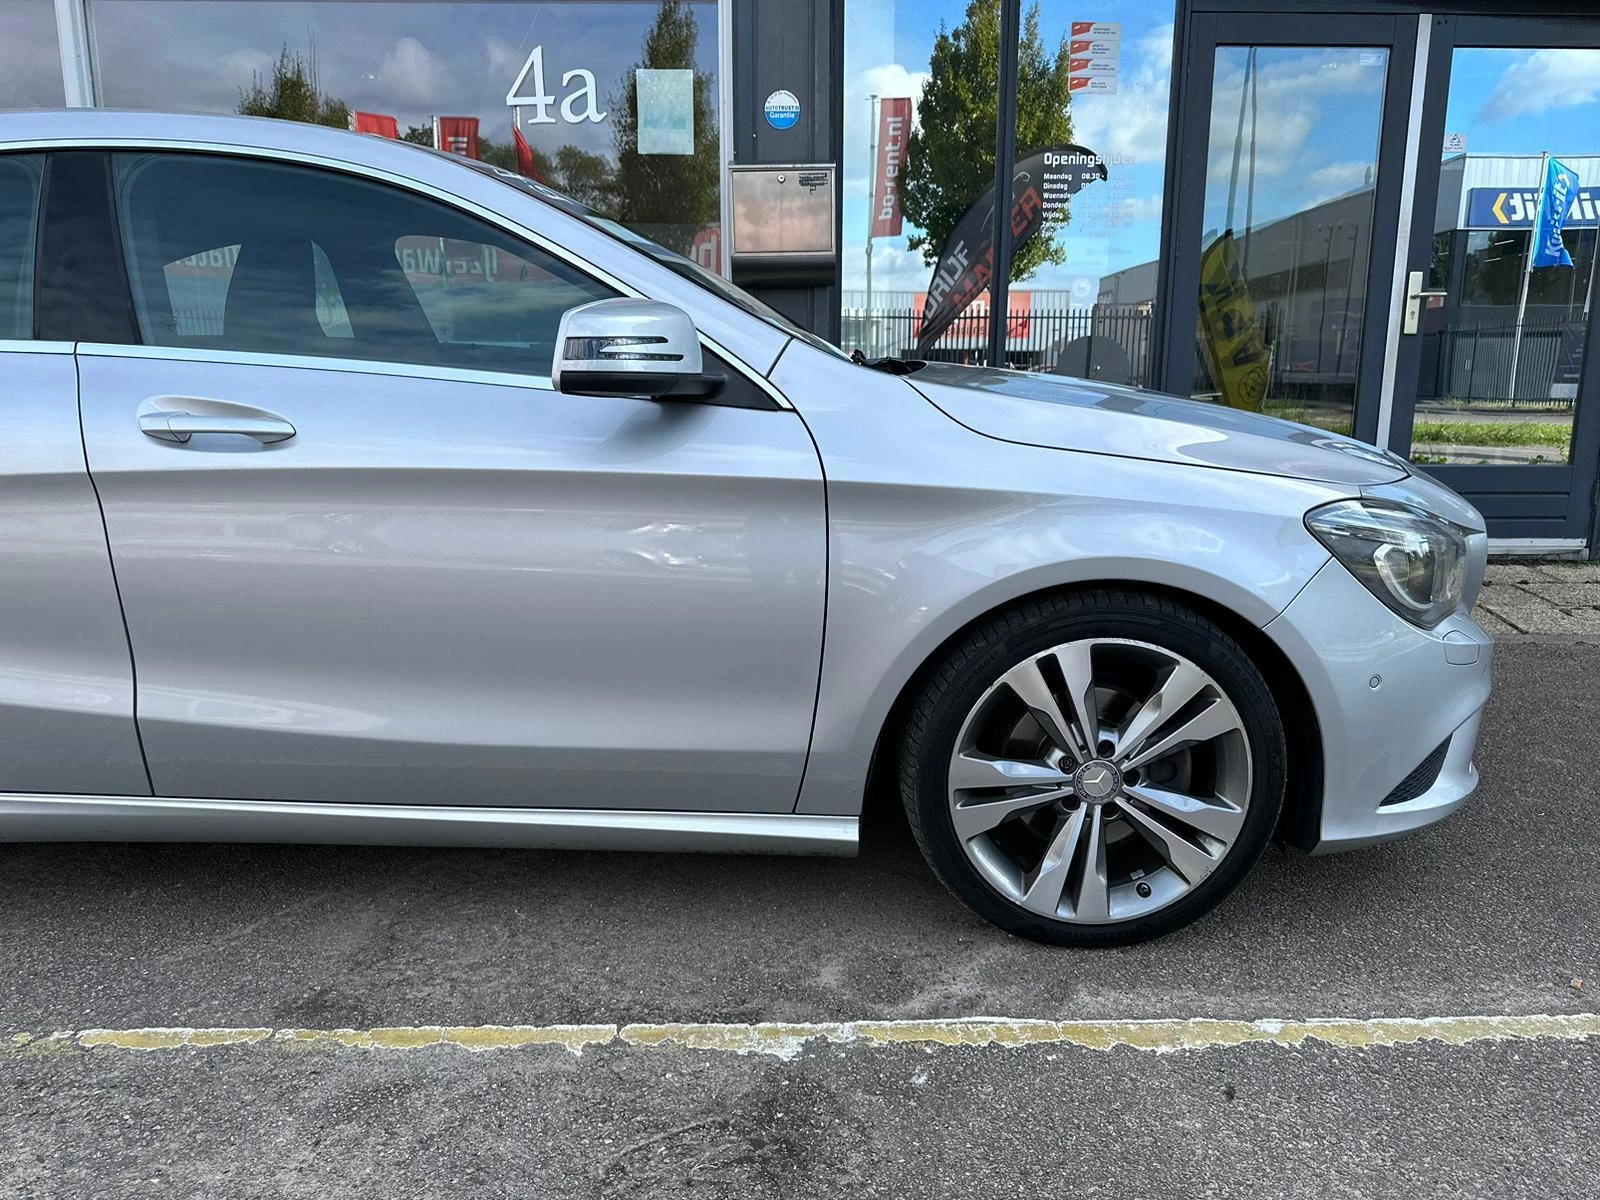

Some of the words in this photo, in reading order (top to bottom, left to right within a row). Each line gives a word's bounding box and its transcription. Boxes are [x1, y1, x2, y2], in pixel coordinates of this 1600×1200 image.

[506, 45, 607, 124] 4a
[769, 111, 795, 119] Garantie
[1043, 172, 1072, 181] Maandag
[1043, 182, 1068, 191] Dinsdag
[1042, 201, 1073, 209] Donderd
[1042, 211, 1064, 219] Vrijdag
[952, 187, 1042, 311] MAER
